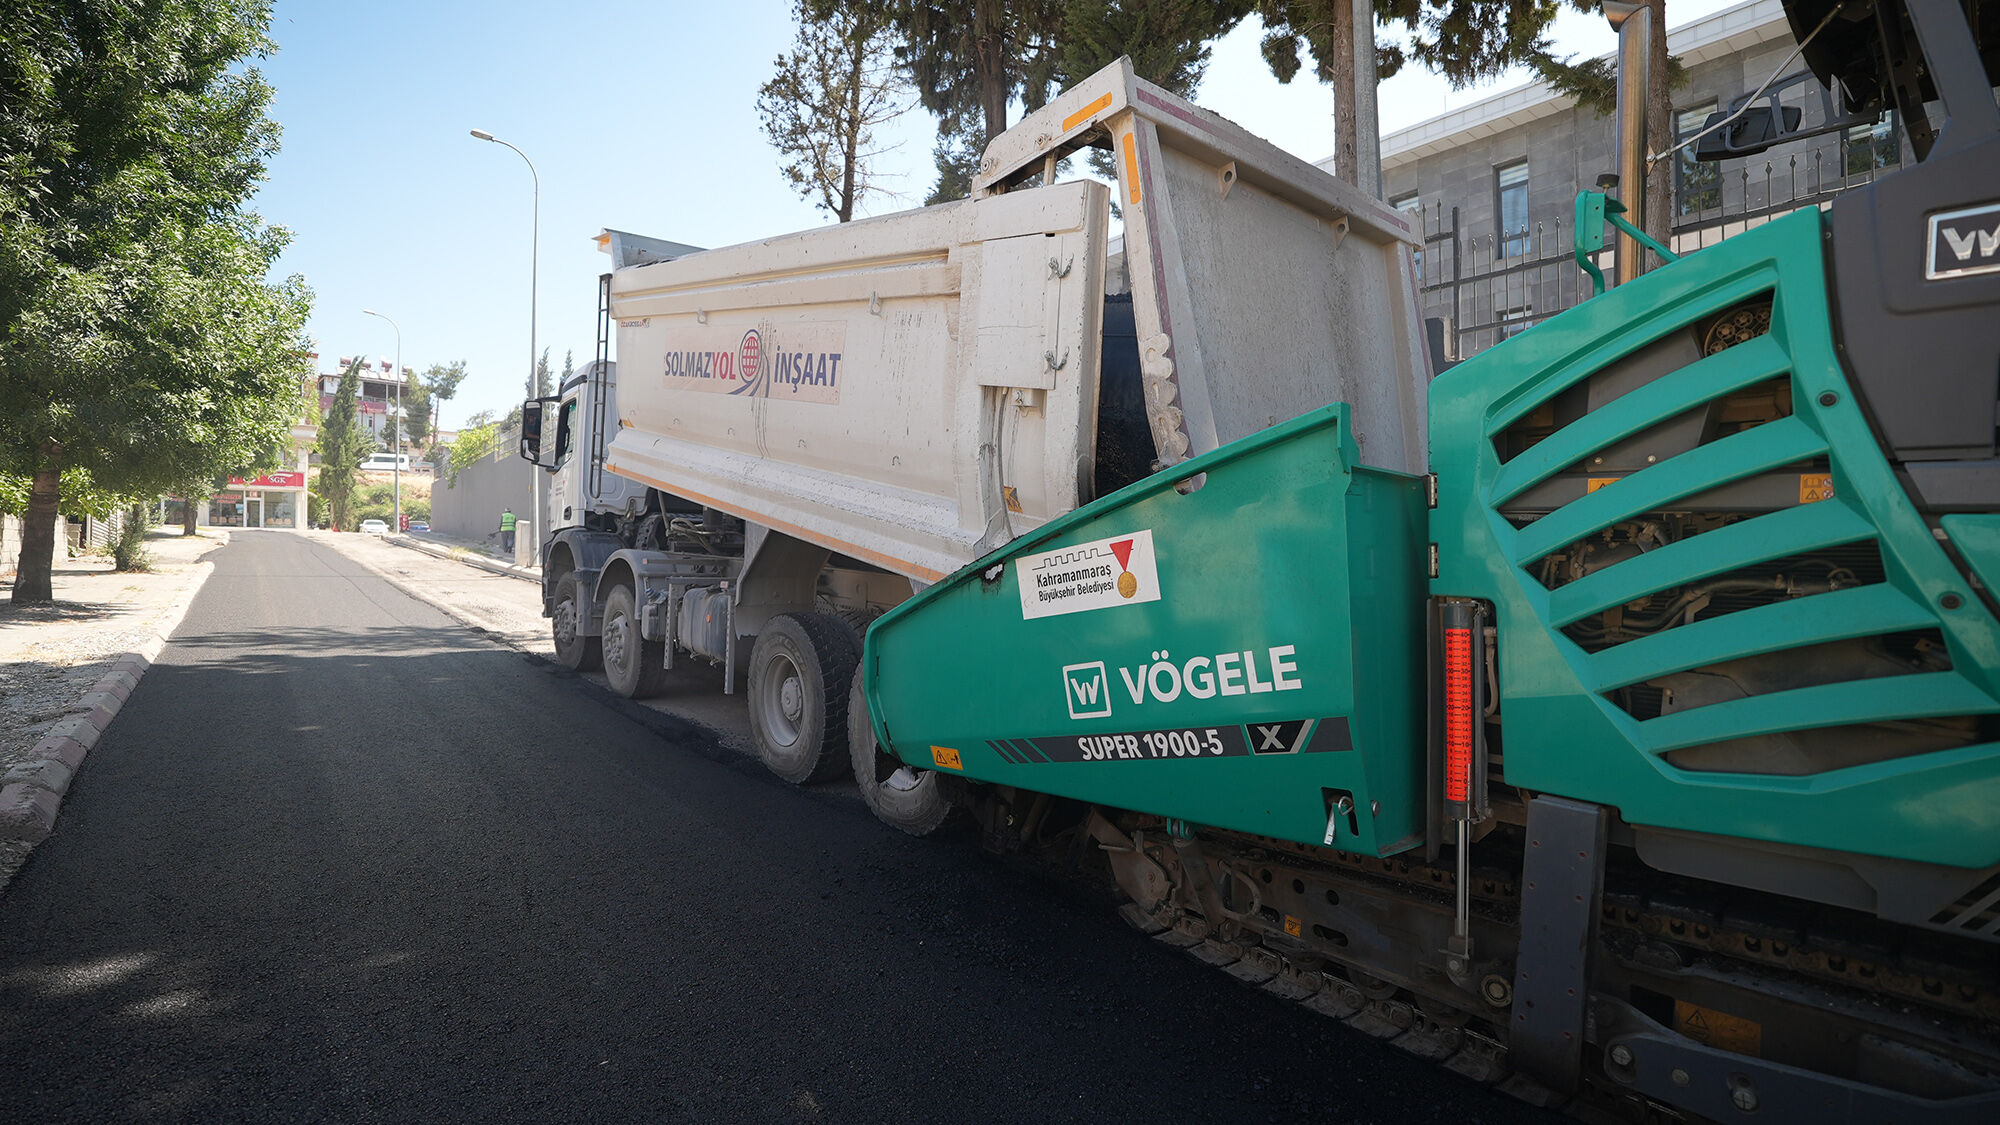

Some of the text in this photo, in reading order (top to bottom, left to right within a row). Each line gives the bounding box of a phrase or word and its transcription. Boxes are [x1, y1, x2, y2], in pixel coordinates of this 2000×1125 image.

[664, 345, 841, 393] SOLMAZYOL İNŞAAT
[1036, 564, 1112, 588] Kahramanmaraş
[1038, 578, 1115, 603] Büyükşehir Belediyesi
[1119, 644, 1302, 704] VÖGELE
[1076, 724, 1287, 761] SUPER 1900-5 X
